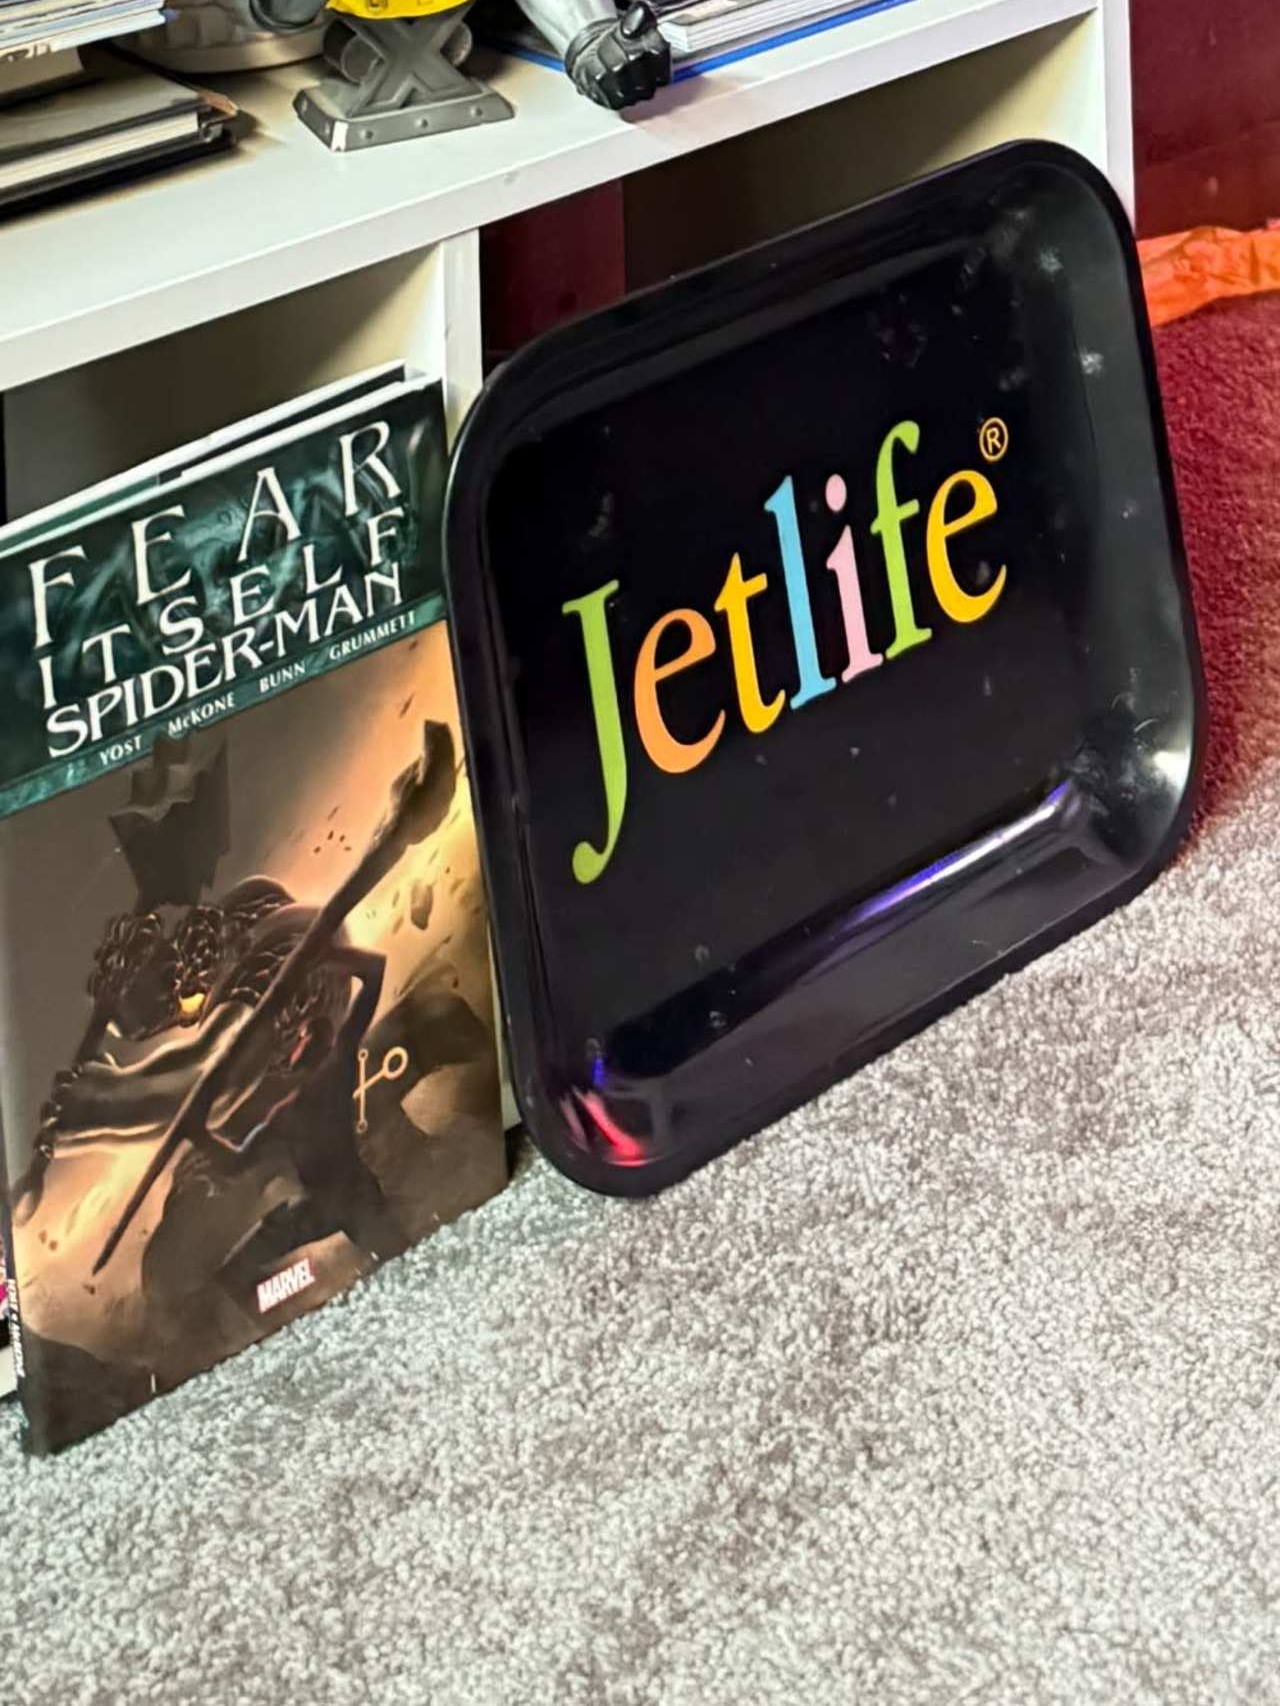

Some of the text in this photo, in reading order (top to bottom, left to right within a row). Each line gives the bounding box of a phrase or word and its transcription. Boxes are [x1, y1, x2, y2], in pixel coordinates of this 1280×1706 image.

[28, 420, 403, 651] FEAR
[38, 507, 405, 710] ITSELF
[46, 562, 403, 759] SPIDER-MAN
[99, 612, 418, 766] YOST McKONE BUNN GRUMMETT
[256, 1257, 316, 1315] MARVEL
